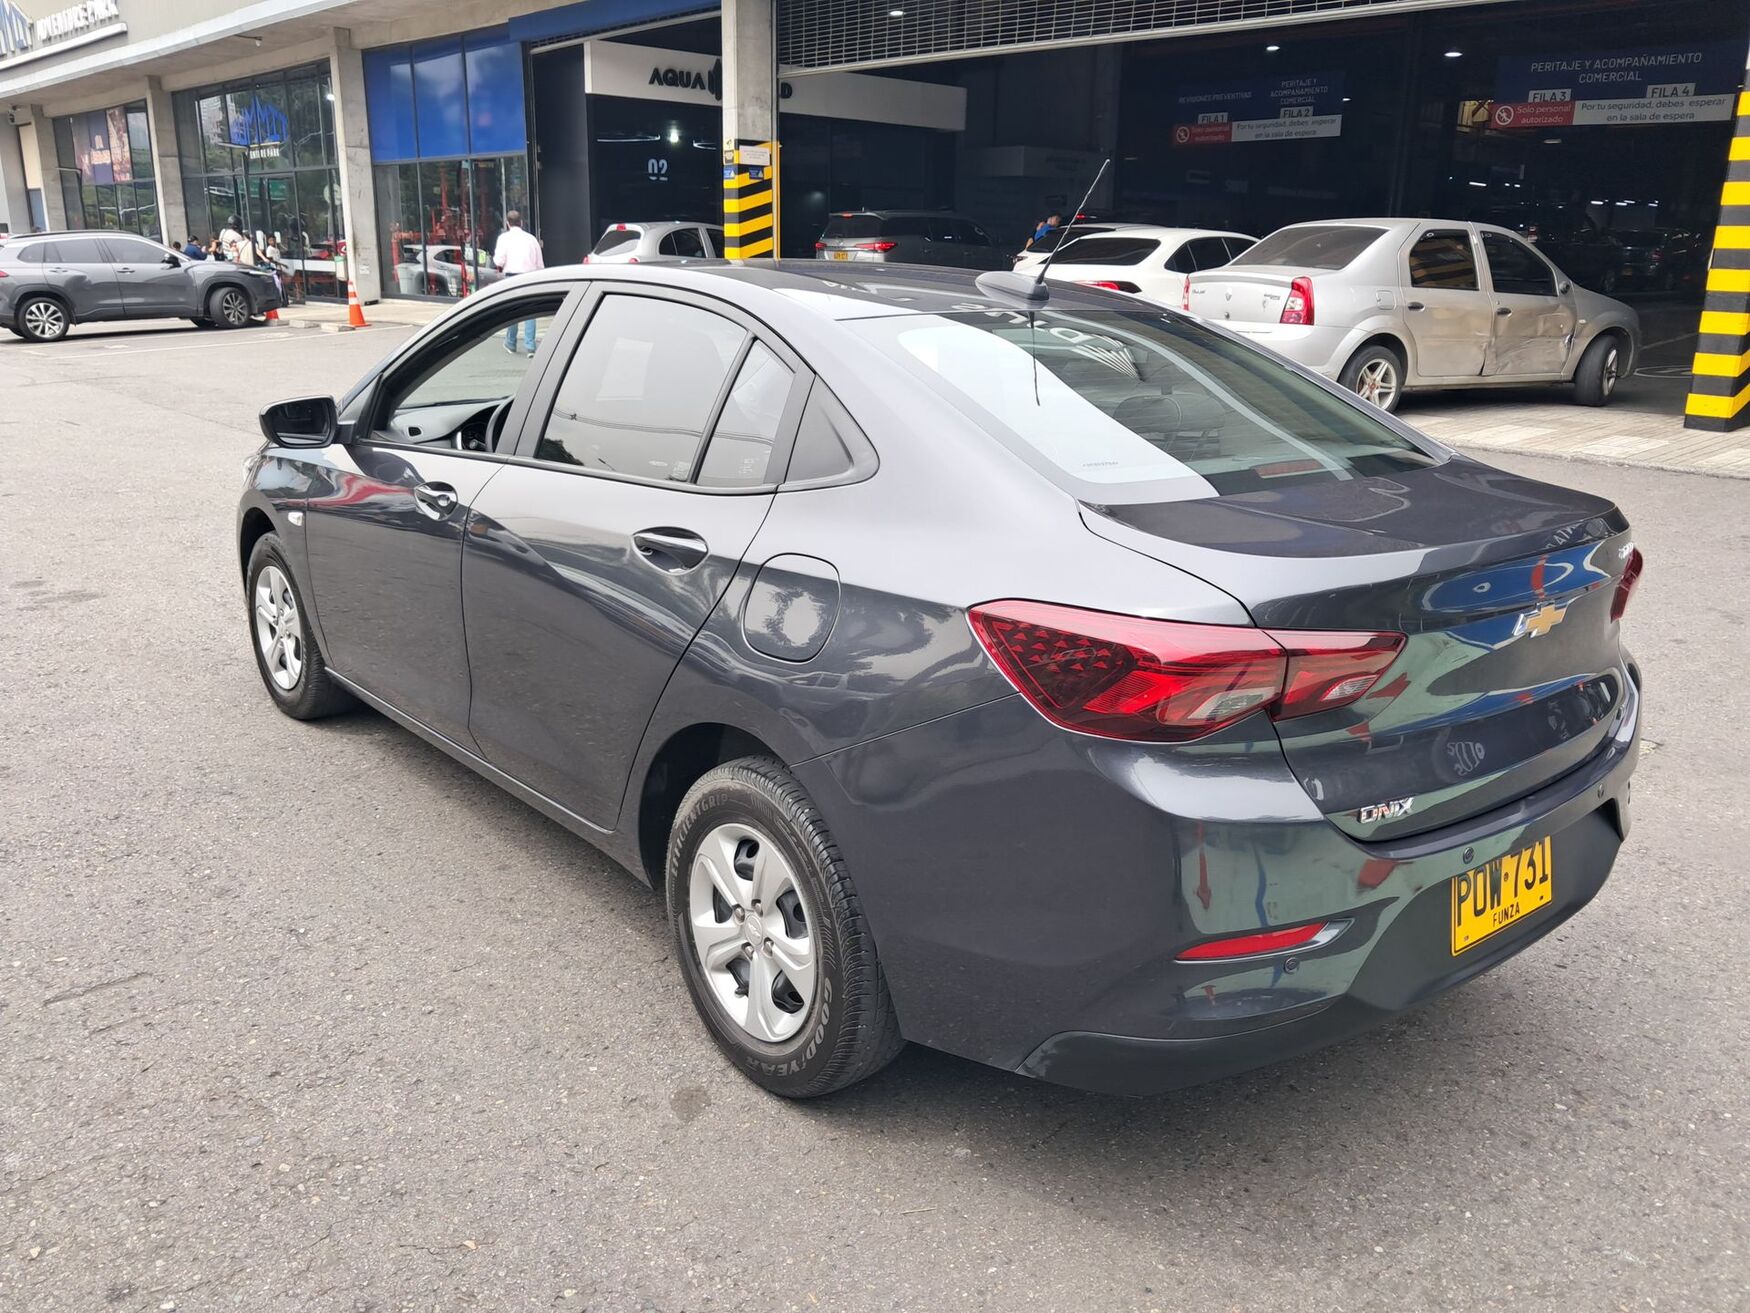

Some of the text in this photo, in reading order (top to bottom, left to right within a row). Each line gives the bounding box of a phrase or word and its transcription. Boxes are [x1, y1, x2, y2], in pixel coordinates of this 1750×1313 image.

[1531, 52, 1702, 73] PERITAJE Y ACOMPAÑAMIENTO
[649, 67, 706, 90] AQUA
[1579, 71, 1642, 83] COMERCIAL
[1533, 91, 1567, 102] FILA 3
[1651, 86, 1690, 97] FILA 4
[1536, 104, 1572, 114] personal
[1581, 103, 1596, 111] Por
[1656, 100, 1685, 108] debes
[1689, 98, 1725, 108] esperar
[1284, 108, 1310, 118] FILA 2
[1620, 113, 1627, 121] la
[1630, 112, 1647, 120] sala
[1649, 112, 1660, 120] de
[1663, 111, 1695, 121] espera
[1202, 115, 1219, 123] FILA
[1521, 115, 1564, 124] autorizado
[648, 158, 668, 181] 02
[1359, 797, 1414, 823] ONIX
[1493, 902, 1520, 927] FUNZA
